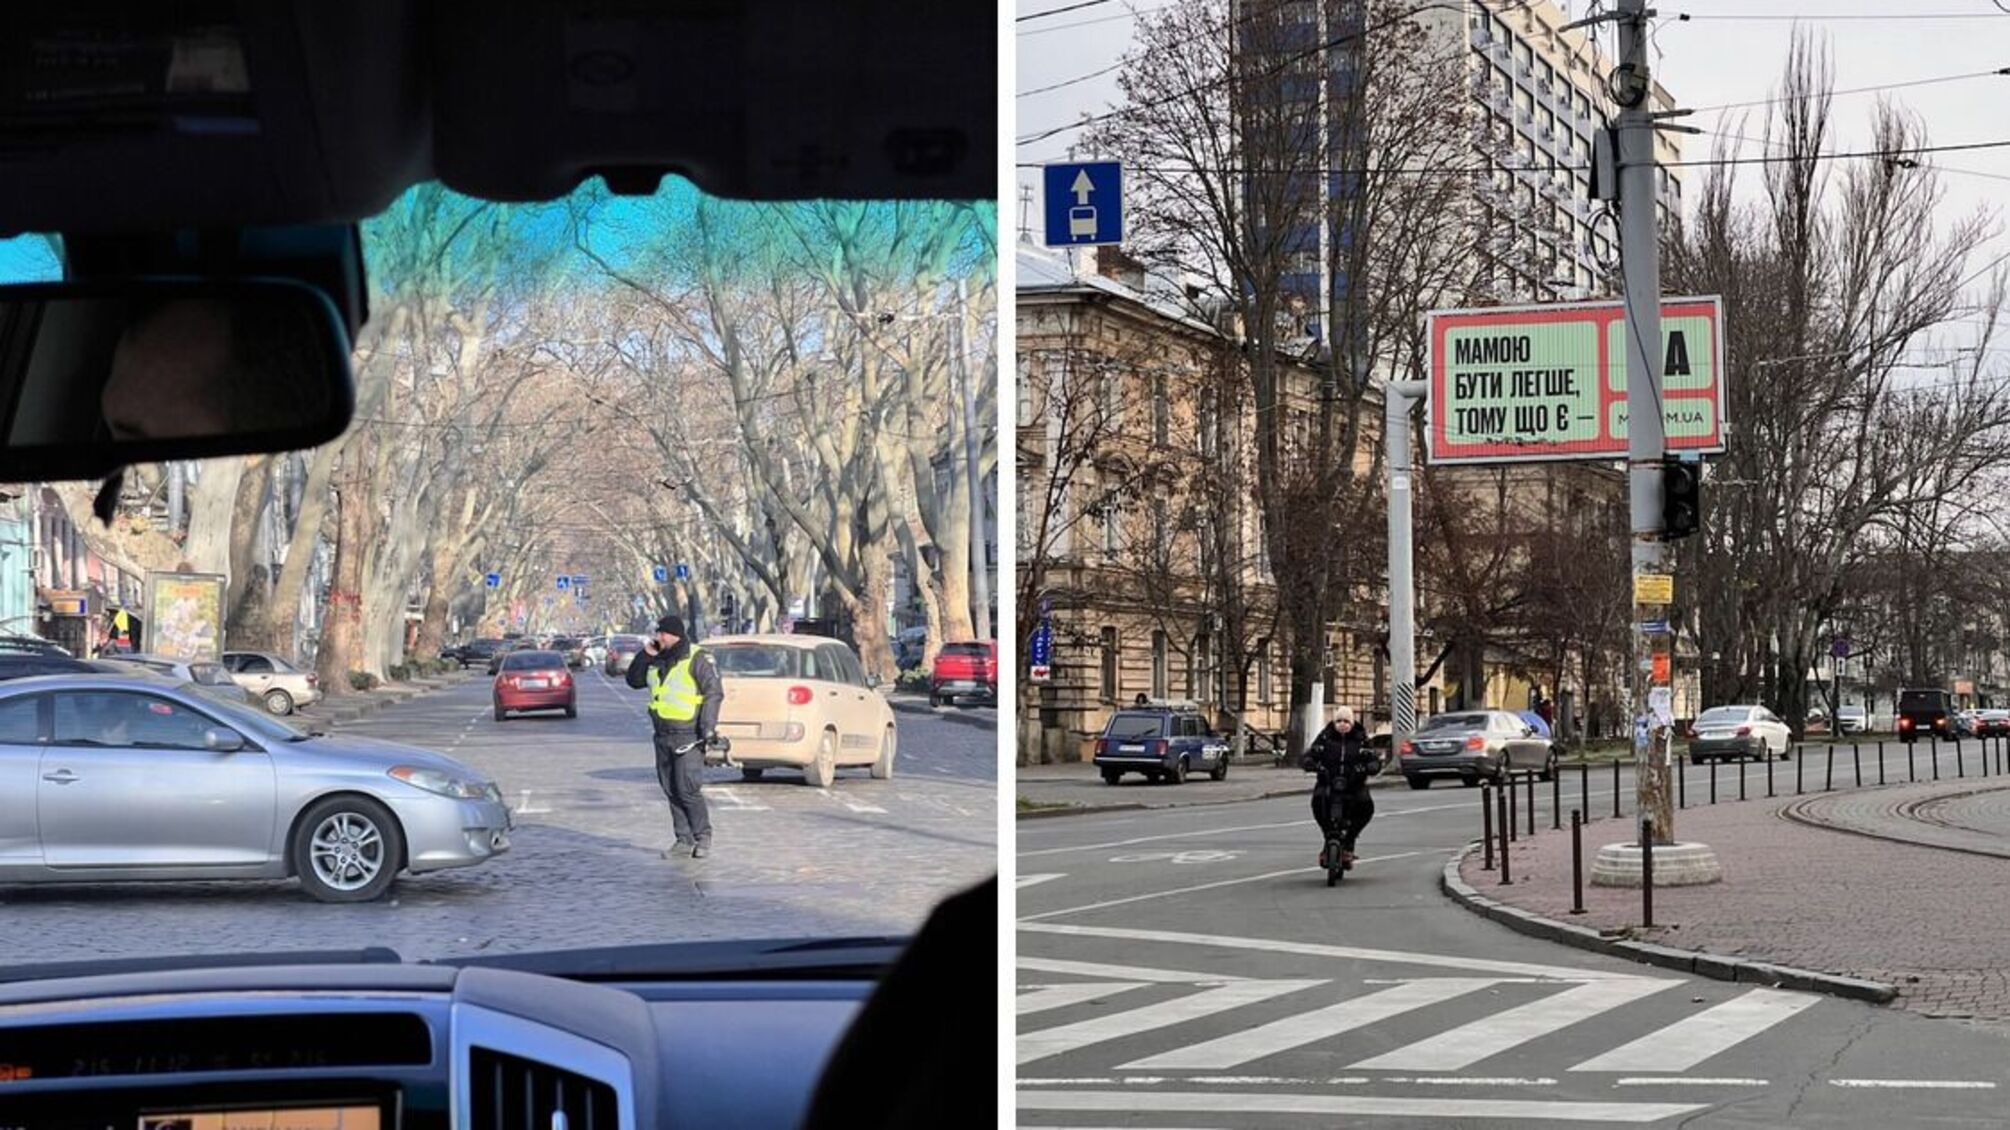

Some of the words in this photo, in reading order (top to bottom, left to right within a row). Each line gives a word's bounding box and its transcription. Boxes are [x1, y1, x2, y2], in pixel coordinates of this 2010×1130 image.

[1455, 336, 1531, 365] МАМОЮ
[1659, 330, 1691, 376] А
[1455, 372, 1503, 400] БУТИ
[1510, 369, 1580, 398] ЛЕГШЕ,
[1455, 406, 1507, 435] ТОМУ
[1515, 405, 1549, 436] ЩО
[1556, 404, 1569, 431] Є
